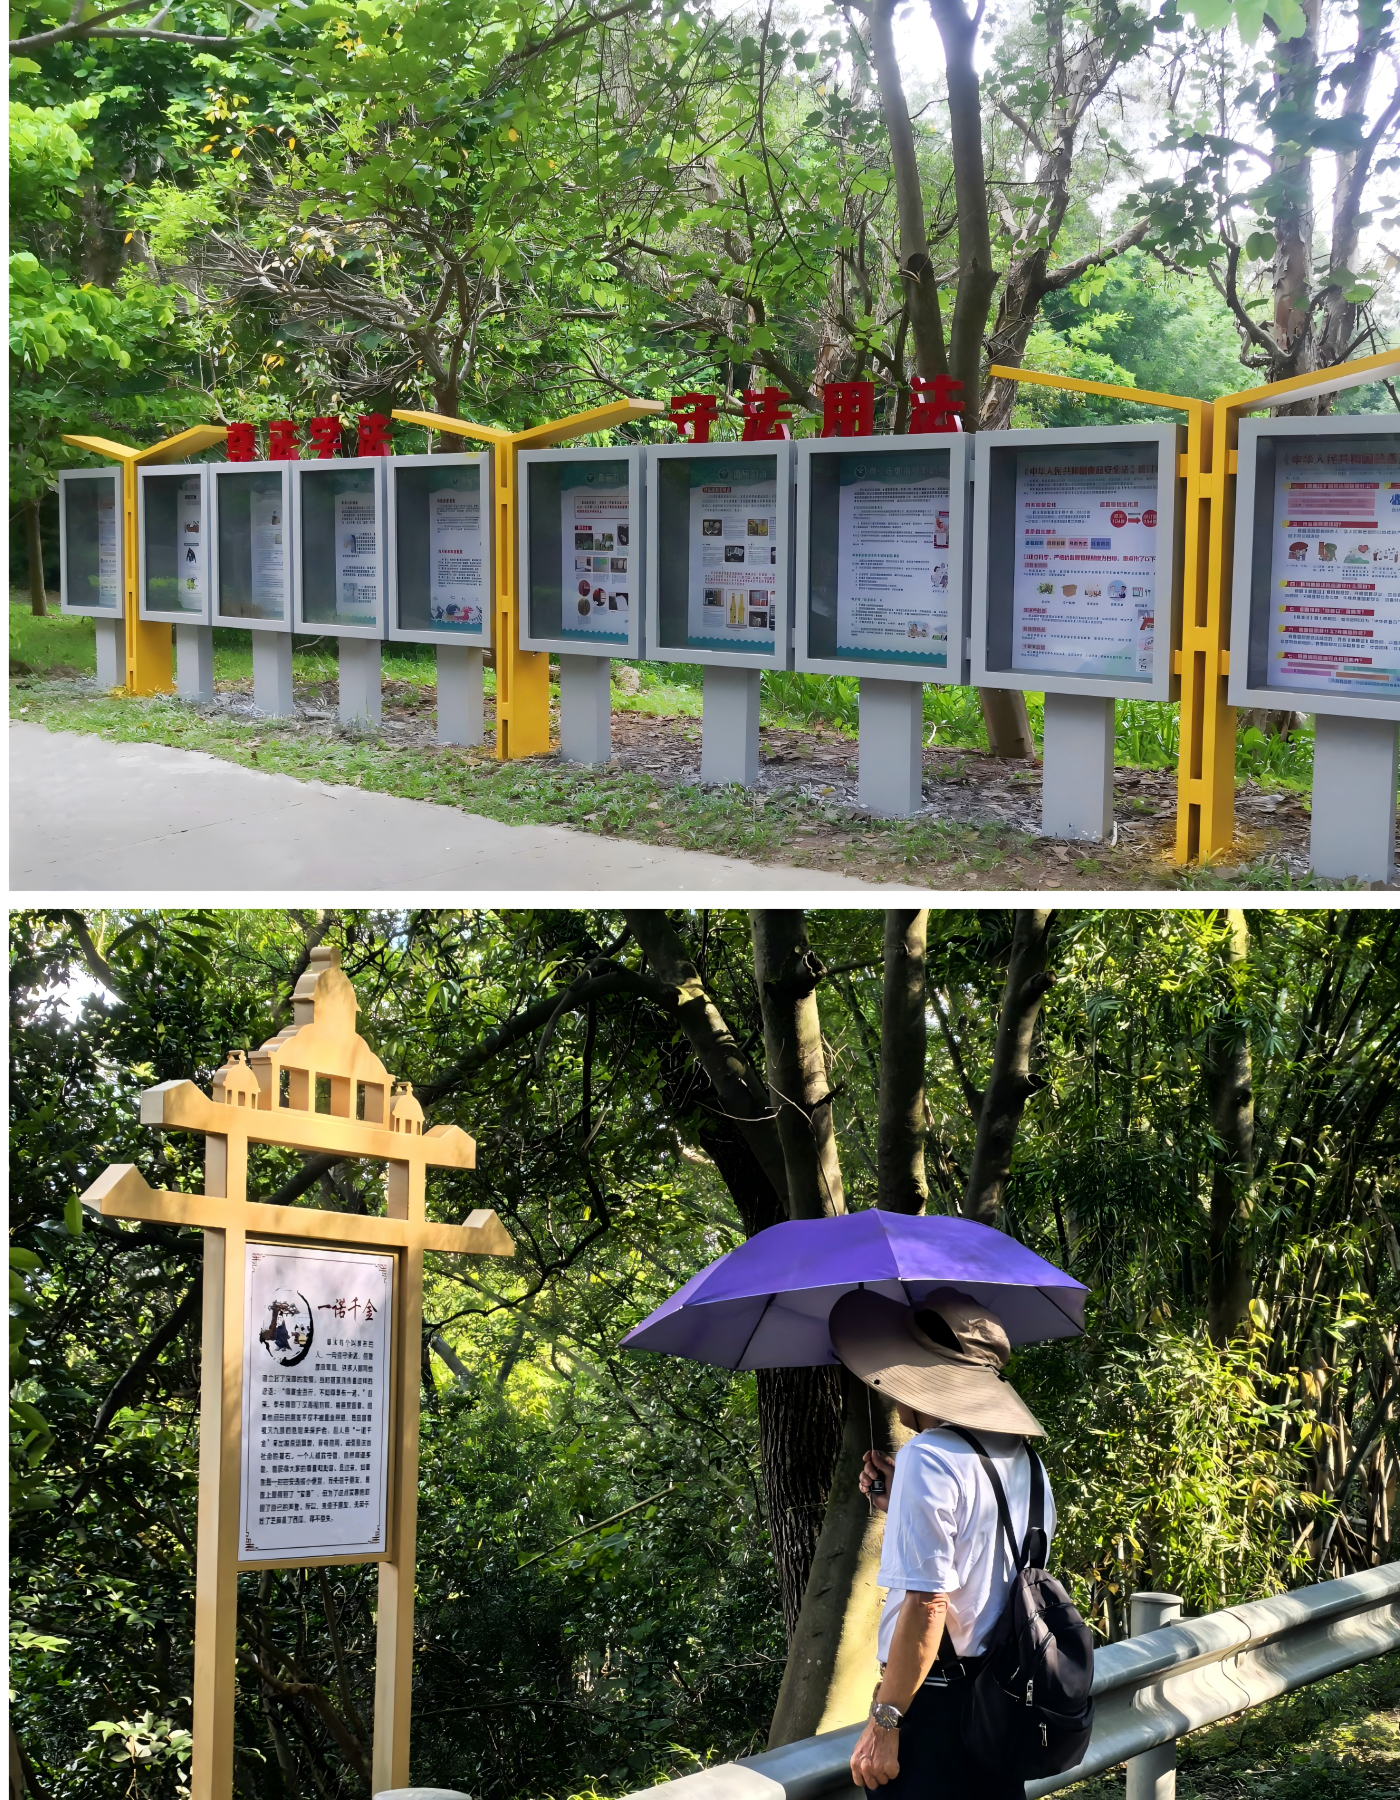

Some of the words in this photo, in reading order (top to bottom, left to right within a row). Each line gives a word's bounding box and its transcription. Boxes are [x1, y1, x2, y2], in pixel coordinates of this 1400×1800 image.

[668, 374, 966, 443] 守法用法
[318, 1297, 378, 1322] 一诺千金
